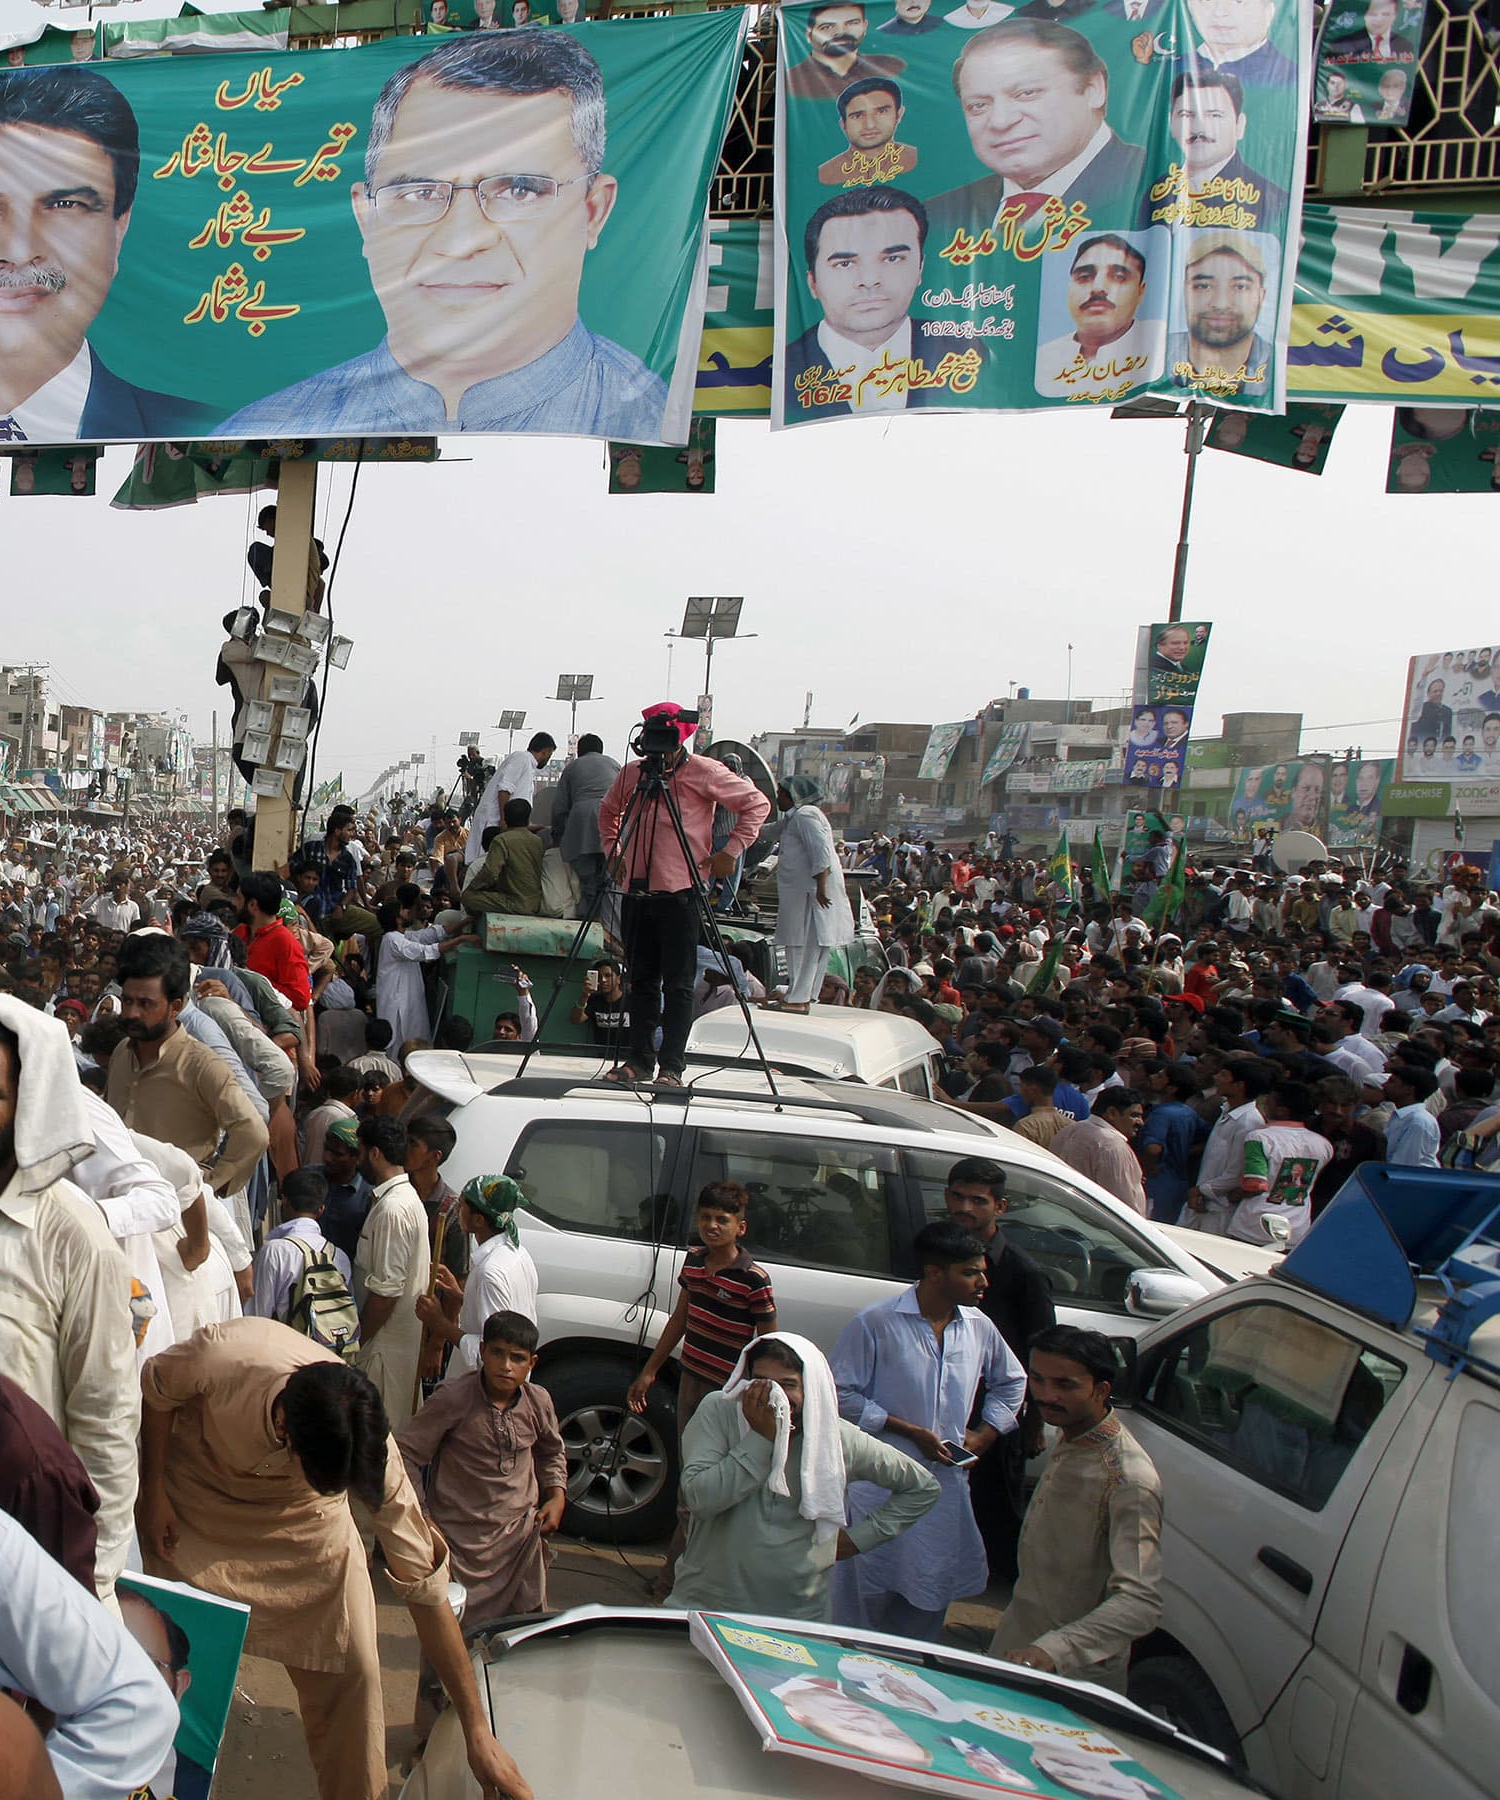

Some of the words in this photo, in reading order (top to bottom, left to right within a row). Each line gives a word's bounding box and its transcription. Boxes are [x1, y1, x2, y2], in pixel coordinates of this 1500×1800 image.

[216, 67, 305, 111] میاں
[243, 122, 357, 186] تیرے
[842, 150, 877, 174] ریاض
[1187, 176, 1239, 202] کاشف
[1237, 177, 1261, 204] رانا
[188, 190, 253, 249] شمار
[241, 207, 306, 261] بے
[939, 202, 1028, 266] آمدید
[1013, 195, 1092, 262] خوش
[183, 262, 248, 324] شمار
[235, 280, 300, 336] بے
[921, 321, 957, 337] 16/2
[821, 364, 857, 382] صدر
[856, 348, 906, 407] سلیم
[878, 358, 928, 398] طاہر
[924, 351, 955, 389] محمد
[949, 348, 982, 393] شیخ
[1053, 354, 1092, 384] رشید
[1091, 355, 1149, 381] رمضان
[797, 383, 853, 408] 16/2
[1066, 391, 1090, 402] صدر
[1389, 788, 1443, 799] FRANCHISE
